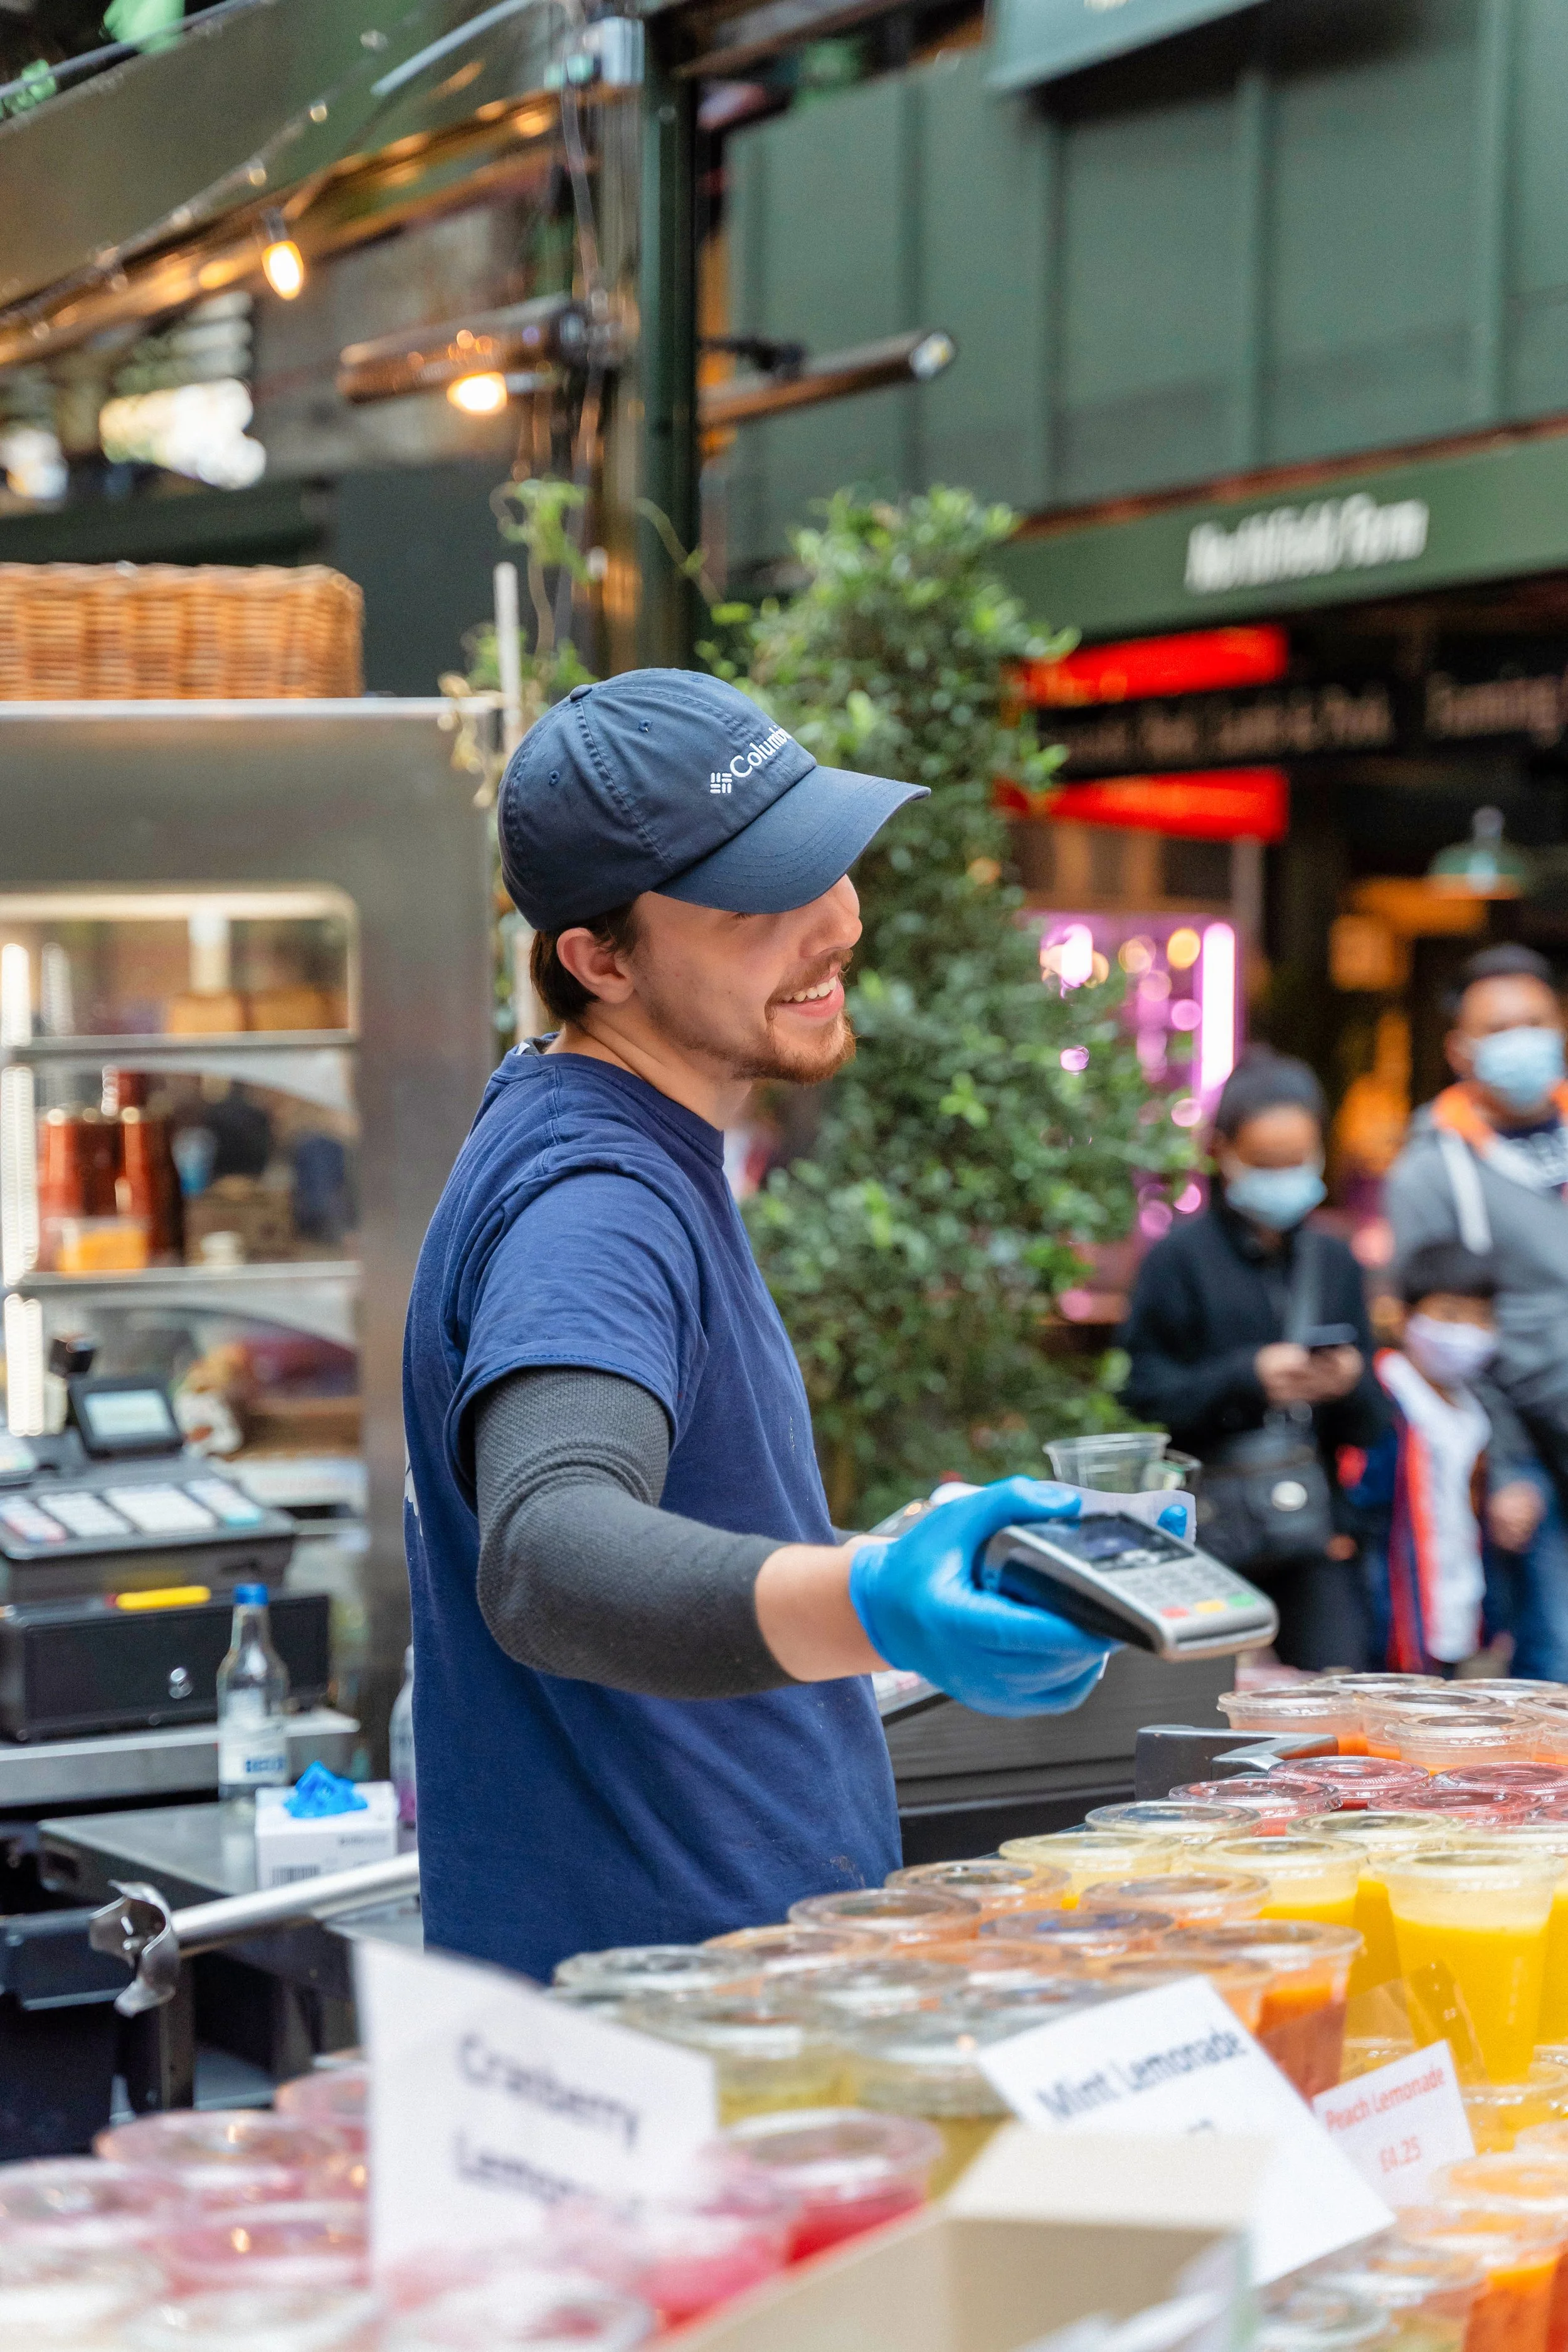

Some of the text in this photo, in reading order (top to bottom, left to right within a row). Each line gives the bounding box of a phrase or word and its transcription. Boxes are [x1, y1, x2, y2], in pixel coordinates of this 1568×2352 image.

[729, 724, 792, 778] Columbi
[1037, 2026, 1246, 2119] Mint Lemonade
[1326, 2063, 1445, 2132] Peach Lemonade
